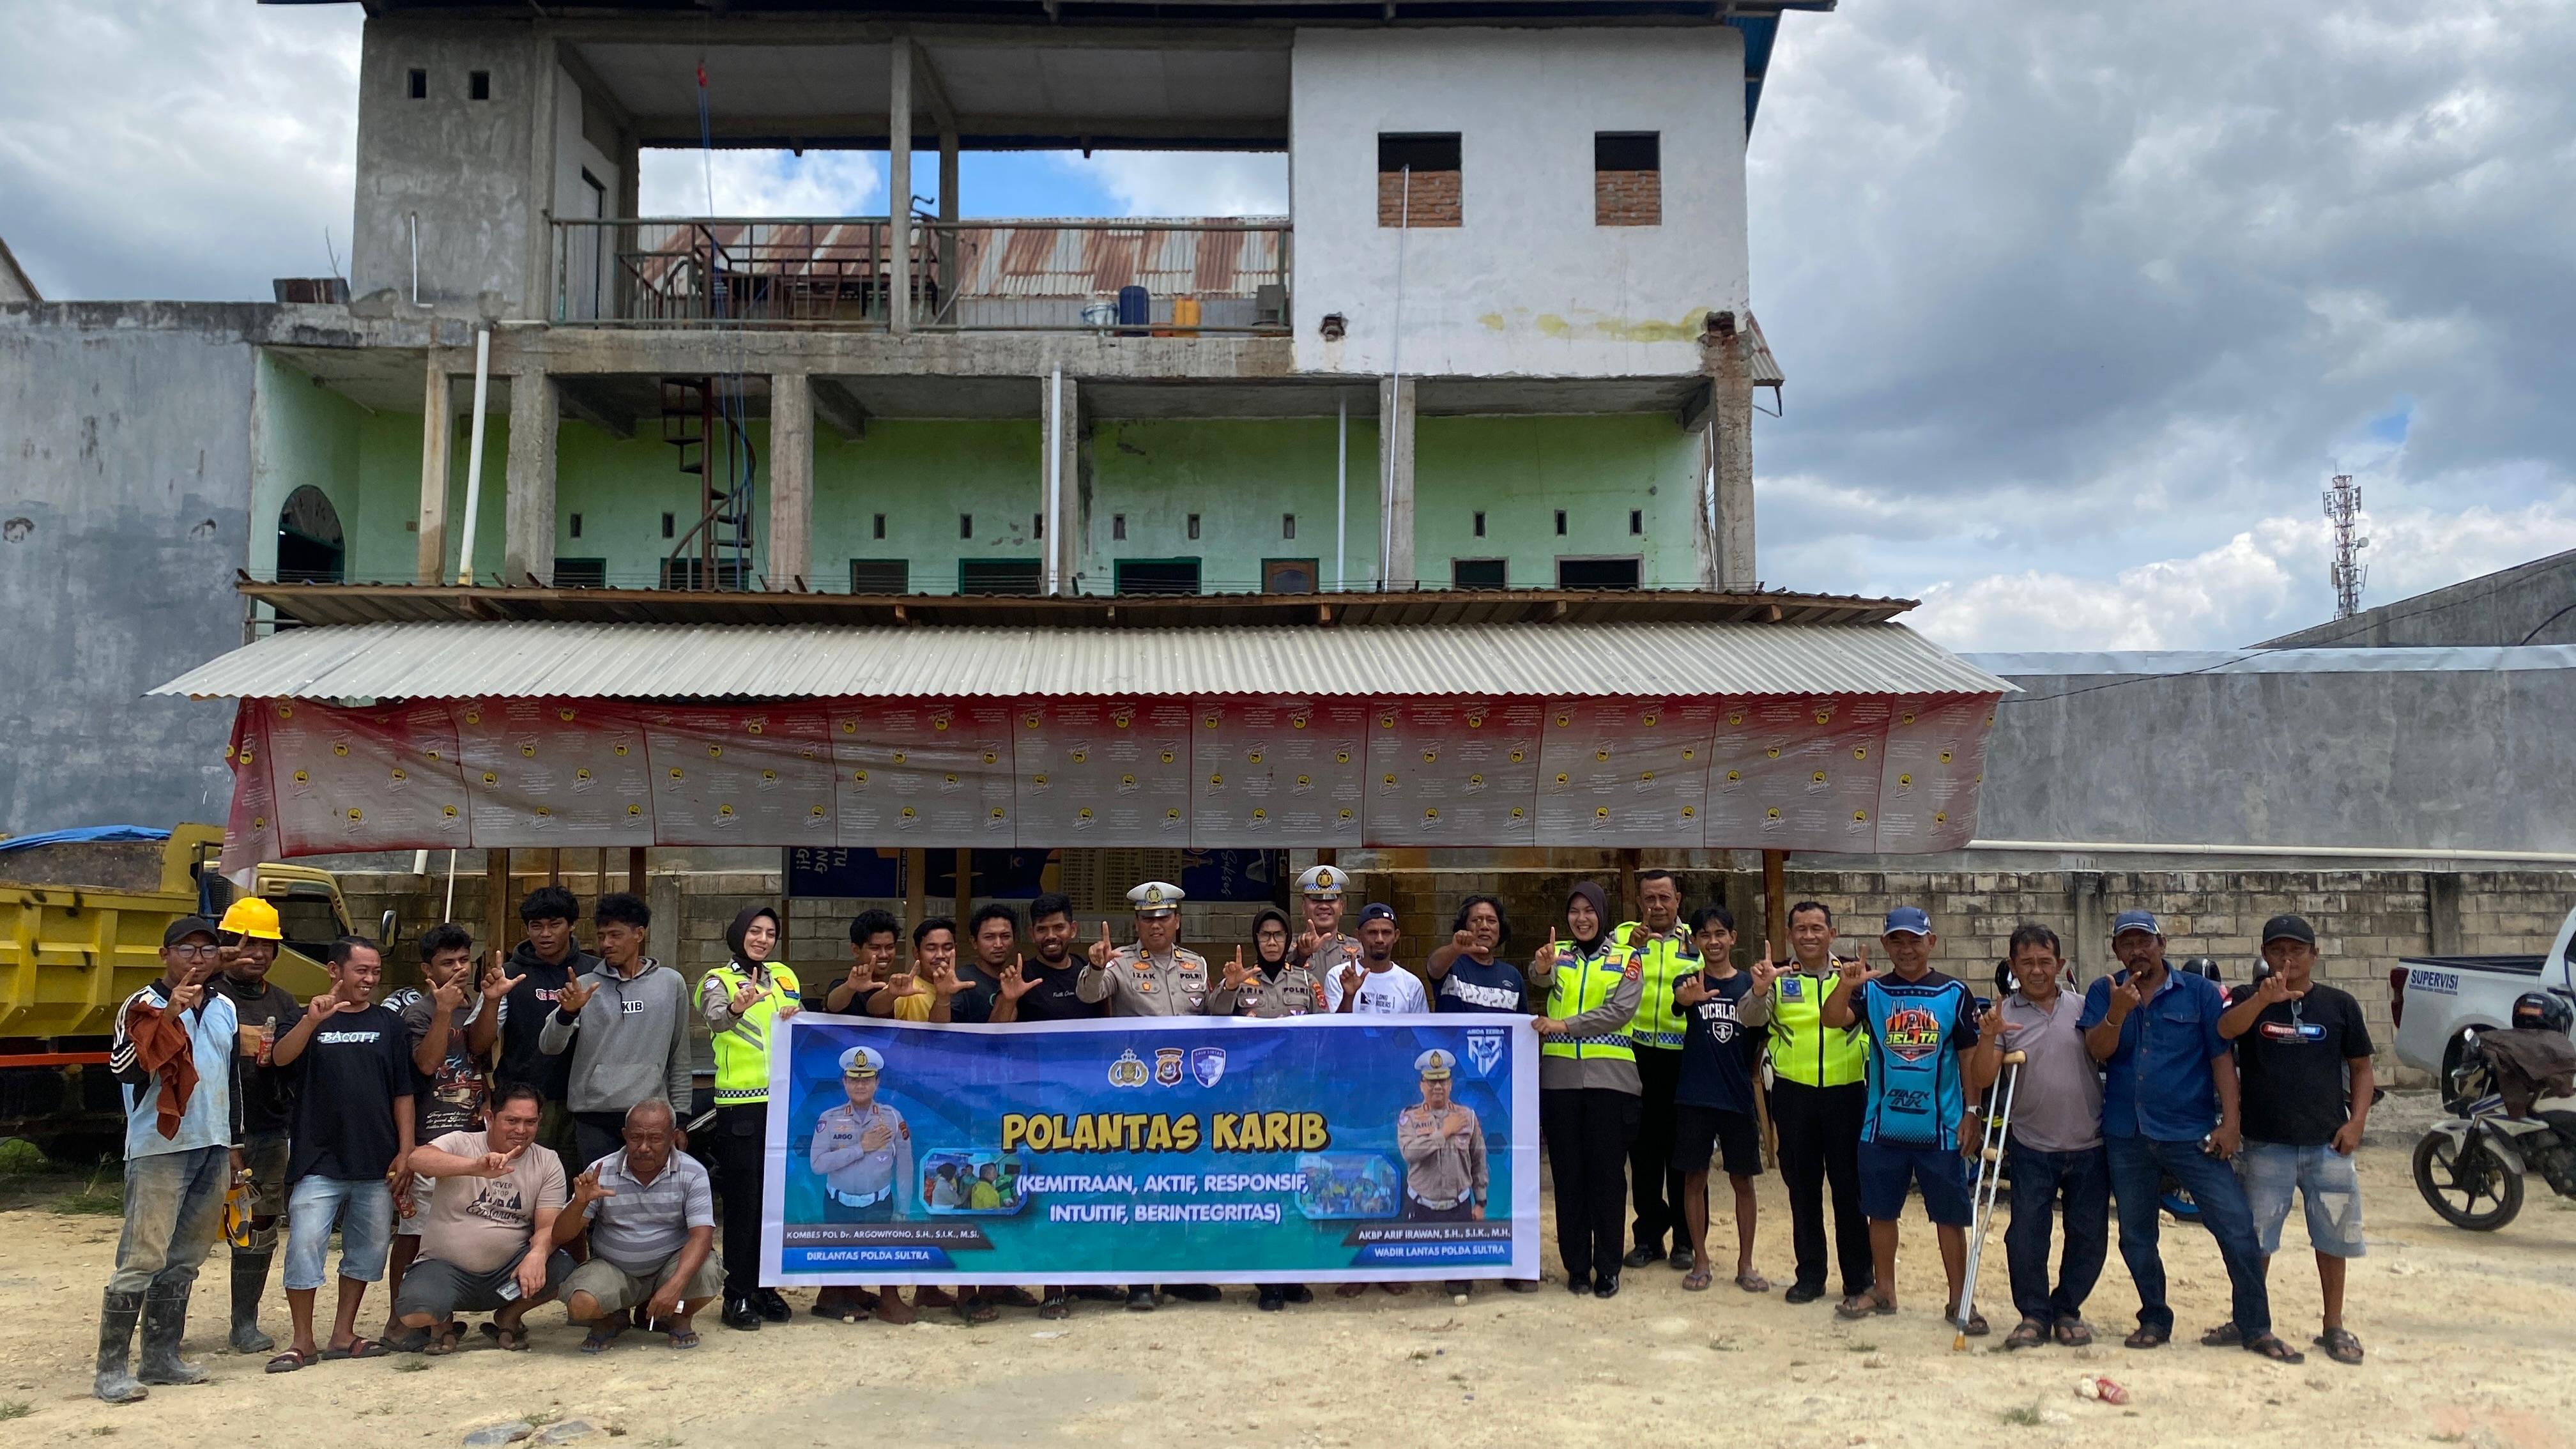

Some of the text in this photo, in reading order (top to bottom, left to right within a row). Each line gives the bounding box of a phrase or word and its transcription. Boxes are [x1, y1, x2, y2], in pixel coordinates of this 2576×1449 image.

[815, 848, 829, 874] NG
[2411, 969, 2459, 990] SUPERVISI
[321, 1031, 376, 1043] BACOT!
[1002, 1112, 1331, 1153] POLANTAS KARIB
[492, 1181, 512, 1189] NEVER
[1016, 1173, 1308, 1196] (KEMITRAAN, AKTIF, RESPONSIF,
[1050, 1203, 1282, 1224] INTUITIF, BERINTEGRITAS)
[1358, 1230, 1382, 1240] AKBP
[1384, 1230, 1404, 1239] ARIF
[1405, 1229, 1442, 1239] IRAWAN,
[806, 1251, 929, 1261] DIRLANTAS POLDA SULTRA
[1375, 1245, 1505, 1257] WADIR LANTAS POLDA SULTRA
